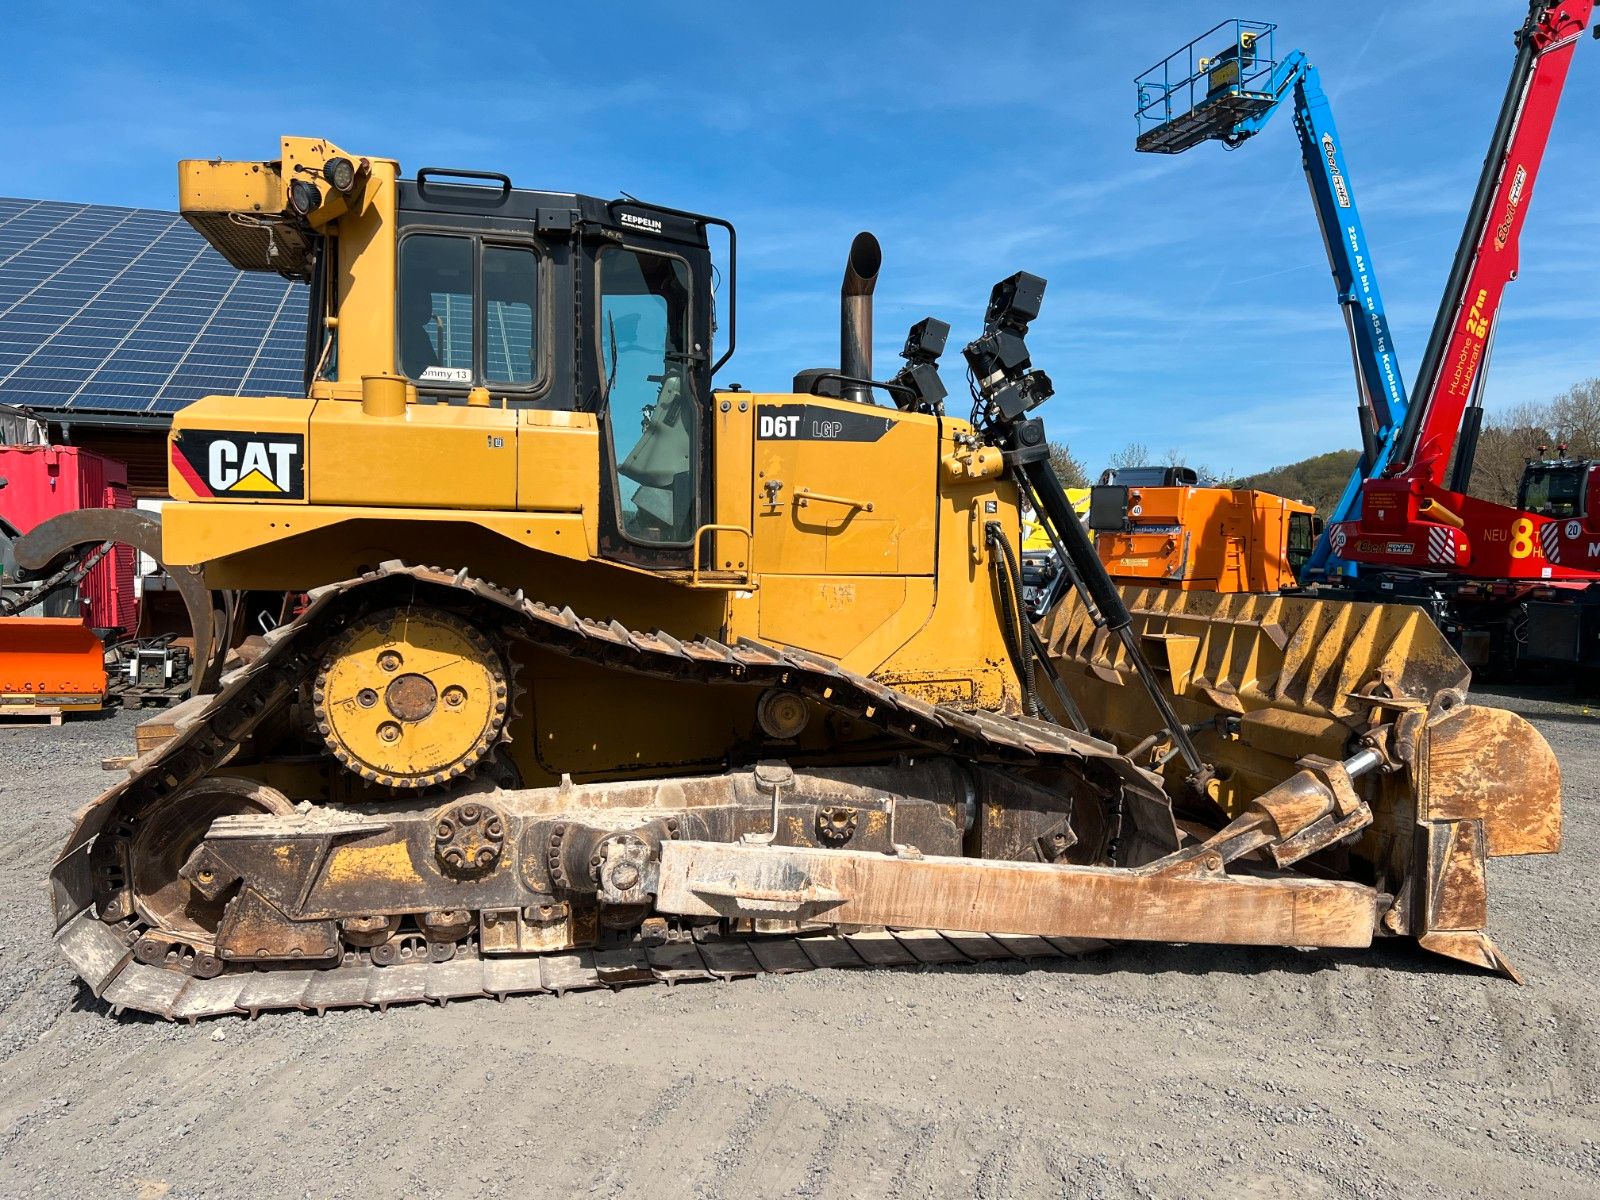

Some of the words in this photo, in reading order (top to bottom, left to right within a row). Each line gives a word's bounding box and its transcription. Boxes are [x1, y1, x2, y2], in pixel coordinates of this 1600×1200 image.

[621, 213, 662, 229] ZEPPELIN
[1347, 225, 1359, 252] 22m
[1355, 255, 1366, 273] AH
[1361, 274, 1370, 294] bis
[1366, 296, 1375, 311] zu
[1371, 313, 1382, 335] 454
[1377, 336, 1386, 353] kg
[1382, 353, 1401, 404] Korblast
[1448, 337, 1472, 395] Hubhöhe
[1466, 288, 1487, 335] 27m
[1459, 343, 1481, 396] Hubkraft
[1475, 317, 1489, 339] 8t
[456, 371, 467, 379] 13
[760, 415, 800, 438] D6T
[812, 420, 842, 438] LGP
[208, 439, 297, 492] CAT
[1337, 534, 1345, 546] 20
[1509, 517, 1534, 559] 8
[1568, 524, 1578, 536] 20
